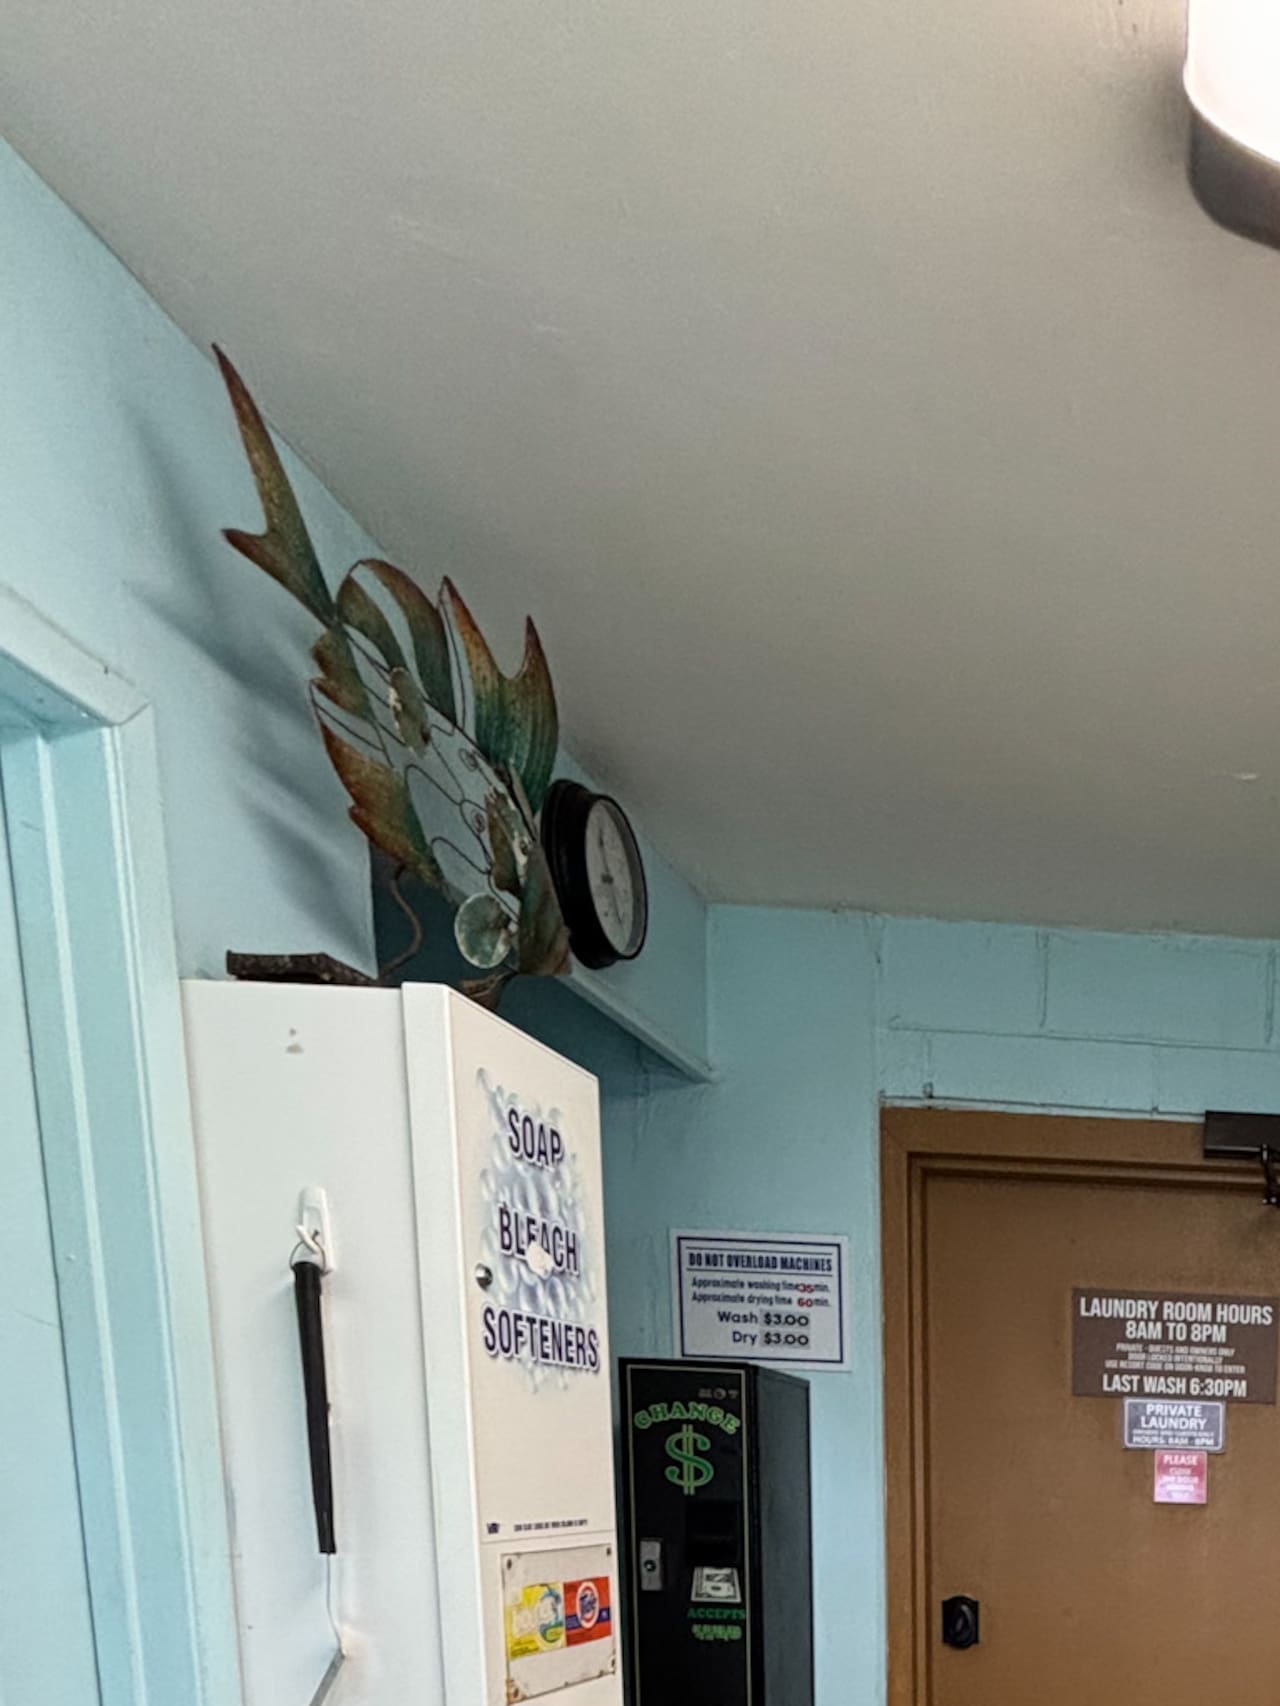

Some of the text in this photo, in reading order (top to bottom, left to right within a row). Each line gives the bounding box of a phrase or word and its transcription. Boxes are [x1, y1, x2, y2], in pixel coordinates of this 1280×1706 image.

[507, 1107, 564, 1166] SOAP
[499, 1203, 579, 1273] BLEACH
[689, 1253, 833, 1272] DO NOT OVERLOAD MACHINES
[691, 1276, 745, 1290] Approximate
[748, 1279, 781, 1292] washing
[692, 1291, 745, 1305] Approximate
[747, 1293, 773, 1306] drying
[775, 1294, 793, 1305] time
[718, 1310, 809, 1327] Wash $3.00
[1080, 1297, 1273, 1325] LAUNDRY ROOM HOURS
[483, 1306, 598, 1368] SOFTENERS
[732, 1331, 809, 1346] Dry $3.00
[1126, 1321, 1227, 1343] 8AM TO 8PM
[1103, 1374, 1247, 1397] LAST WASH 6:30PM
[634, 1401, 740, 1434] CHANGE
[1146, 1404, 1202, 1417] PRIVATE
[1141, 1416, 1207, 1430] LAUNDRY
[1163, 1455, 1198, 1466] PLEASE
[687, 1608, 746, 1619] ACCEPTS
